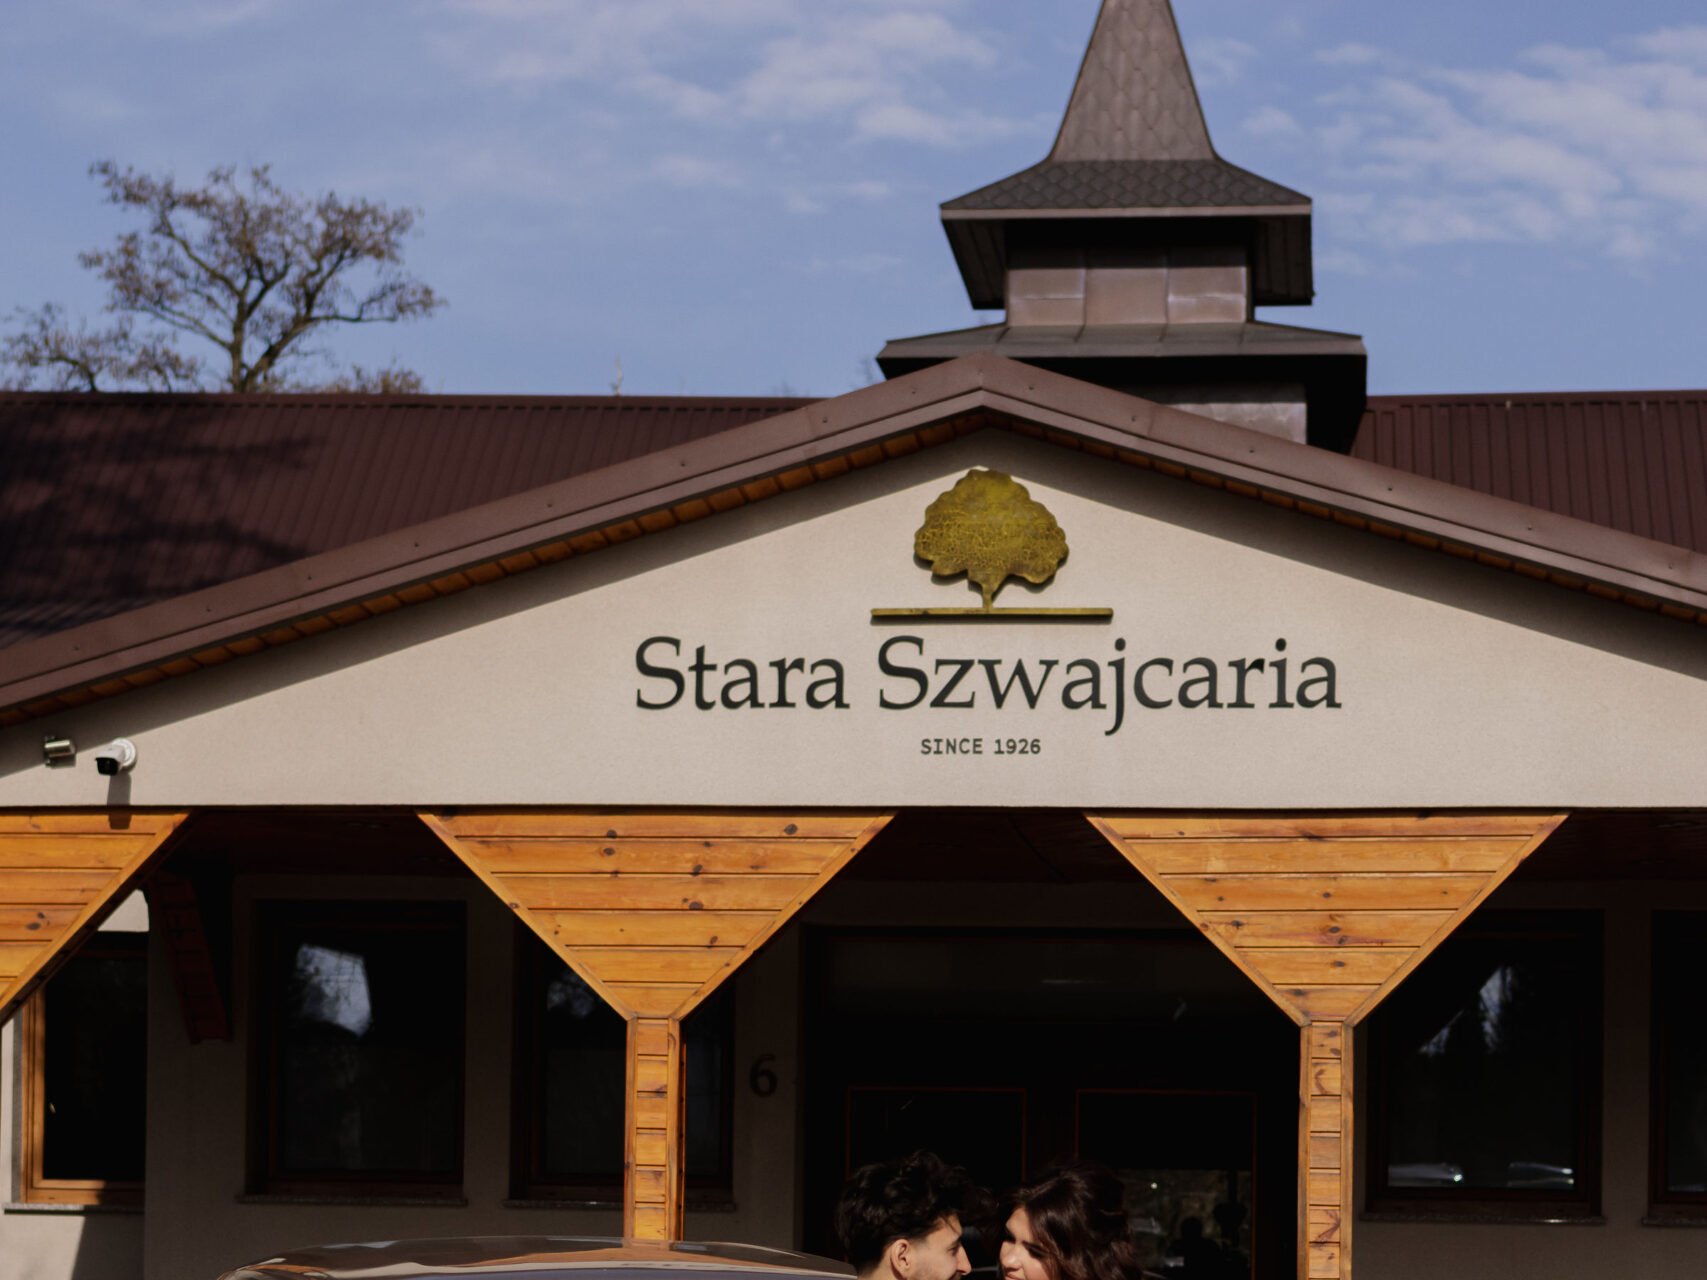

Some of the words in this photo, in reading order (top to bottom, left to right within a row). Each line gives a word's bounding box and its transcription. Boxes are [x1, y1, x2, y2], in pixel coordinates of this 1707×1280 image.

[635, 635, 850, 711] Stara
[877, 635, 1342, 736] Szwajcaria
[920, 737, 983, 755] SINCE
[993, 737, 1042, 755] 1926
[749, 1053, 777, 1098] 6
